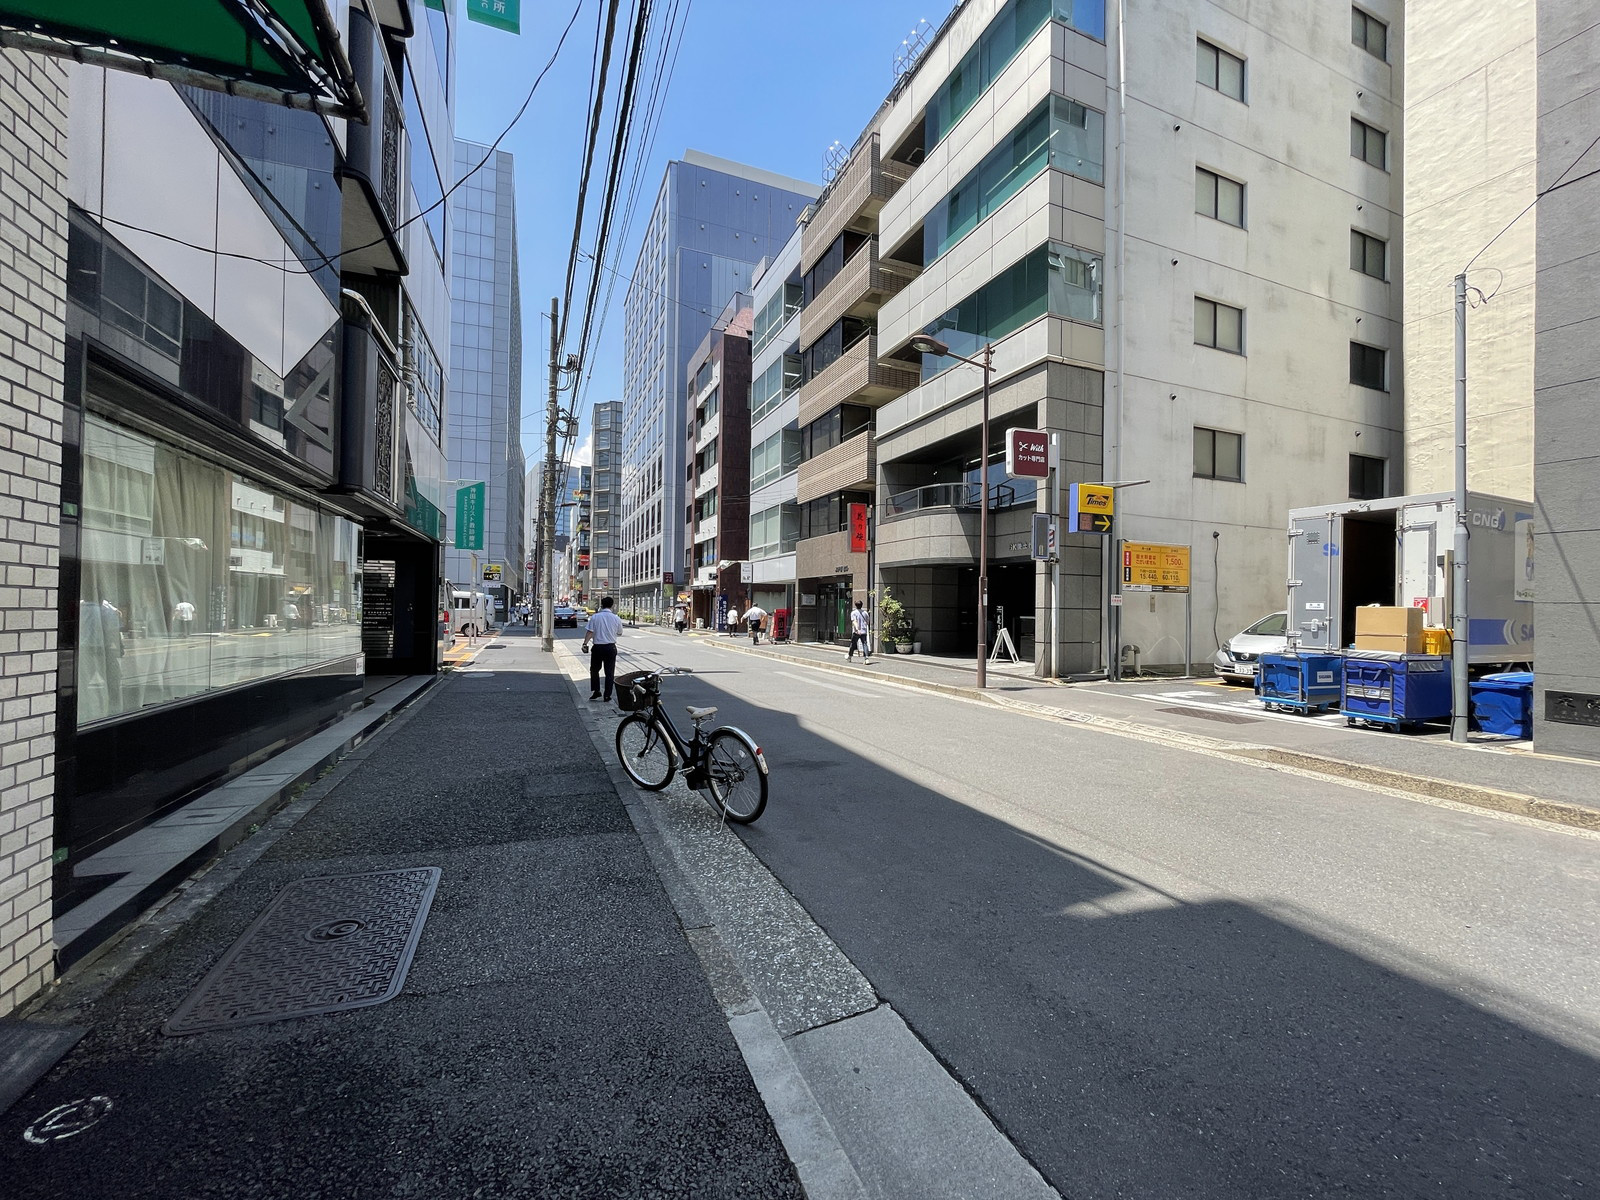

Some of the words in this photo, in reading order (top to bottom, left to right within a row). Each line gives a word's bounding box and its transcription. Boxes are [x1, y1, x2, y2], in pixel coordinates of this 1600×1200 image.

[1030, 443, 1044, 452] With
[1018, 454, 1045, 463] カット専門店
[1086, 494, 1109, 507] Times
[1472, 512, 1499, 529] CNG
